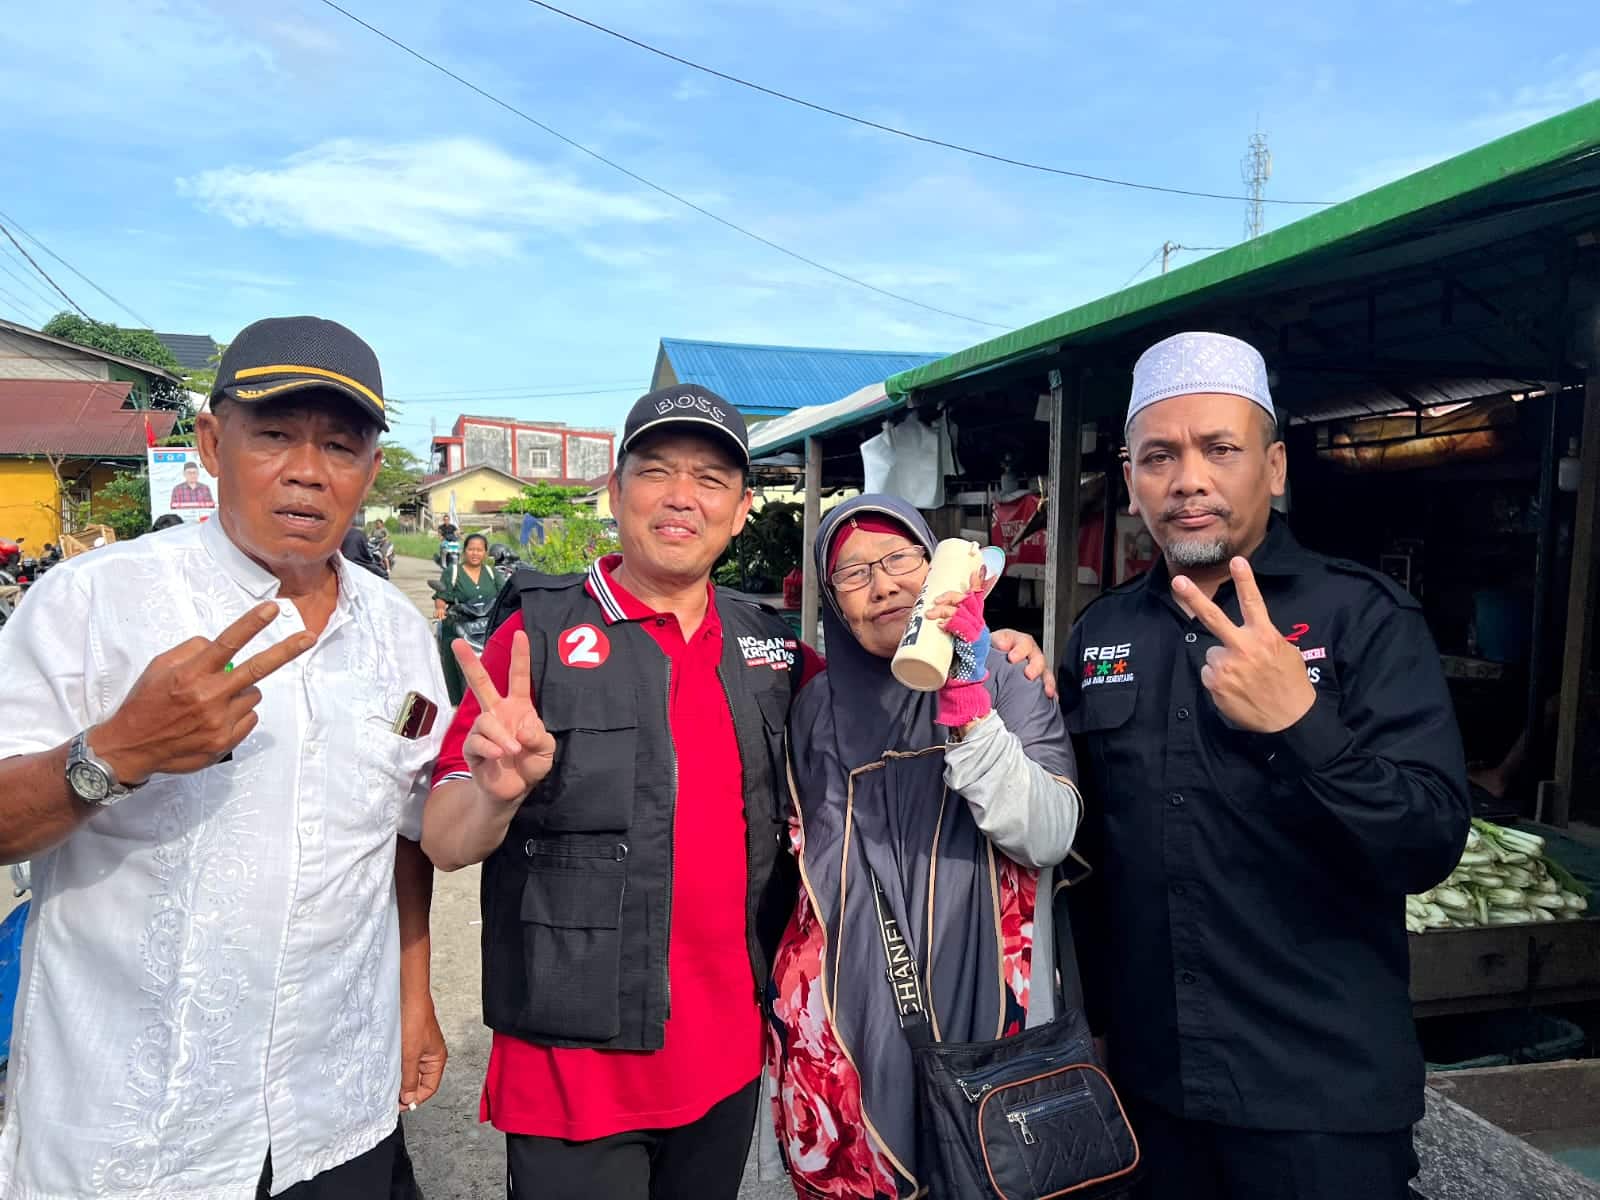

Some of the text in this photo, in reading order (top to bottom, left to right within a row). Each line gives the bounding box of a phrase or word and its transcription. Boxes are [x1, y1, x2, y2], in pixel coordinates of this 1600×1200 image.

[655, 394, 726, 423] BOSS
[565, 626, 600, 665] 2
[1284, 623, 1310, 641] 2
